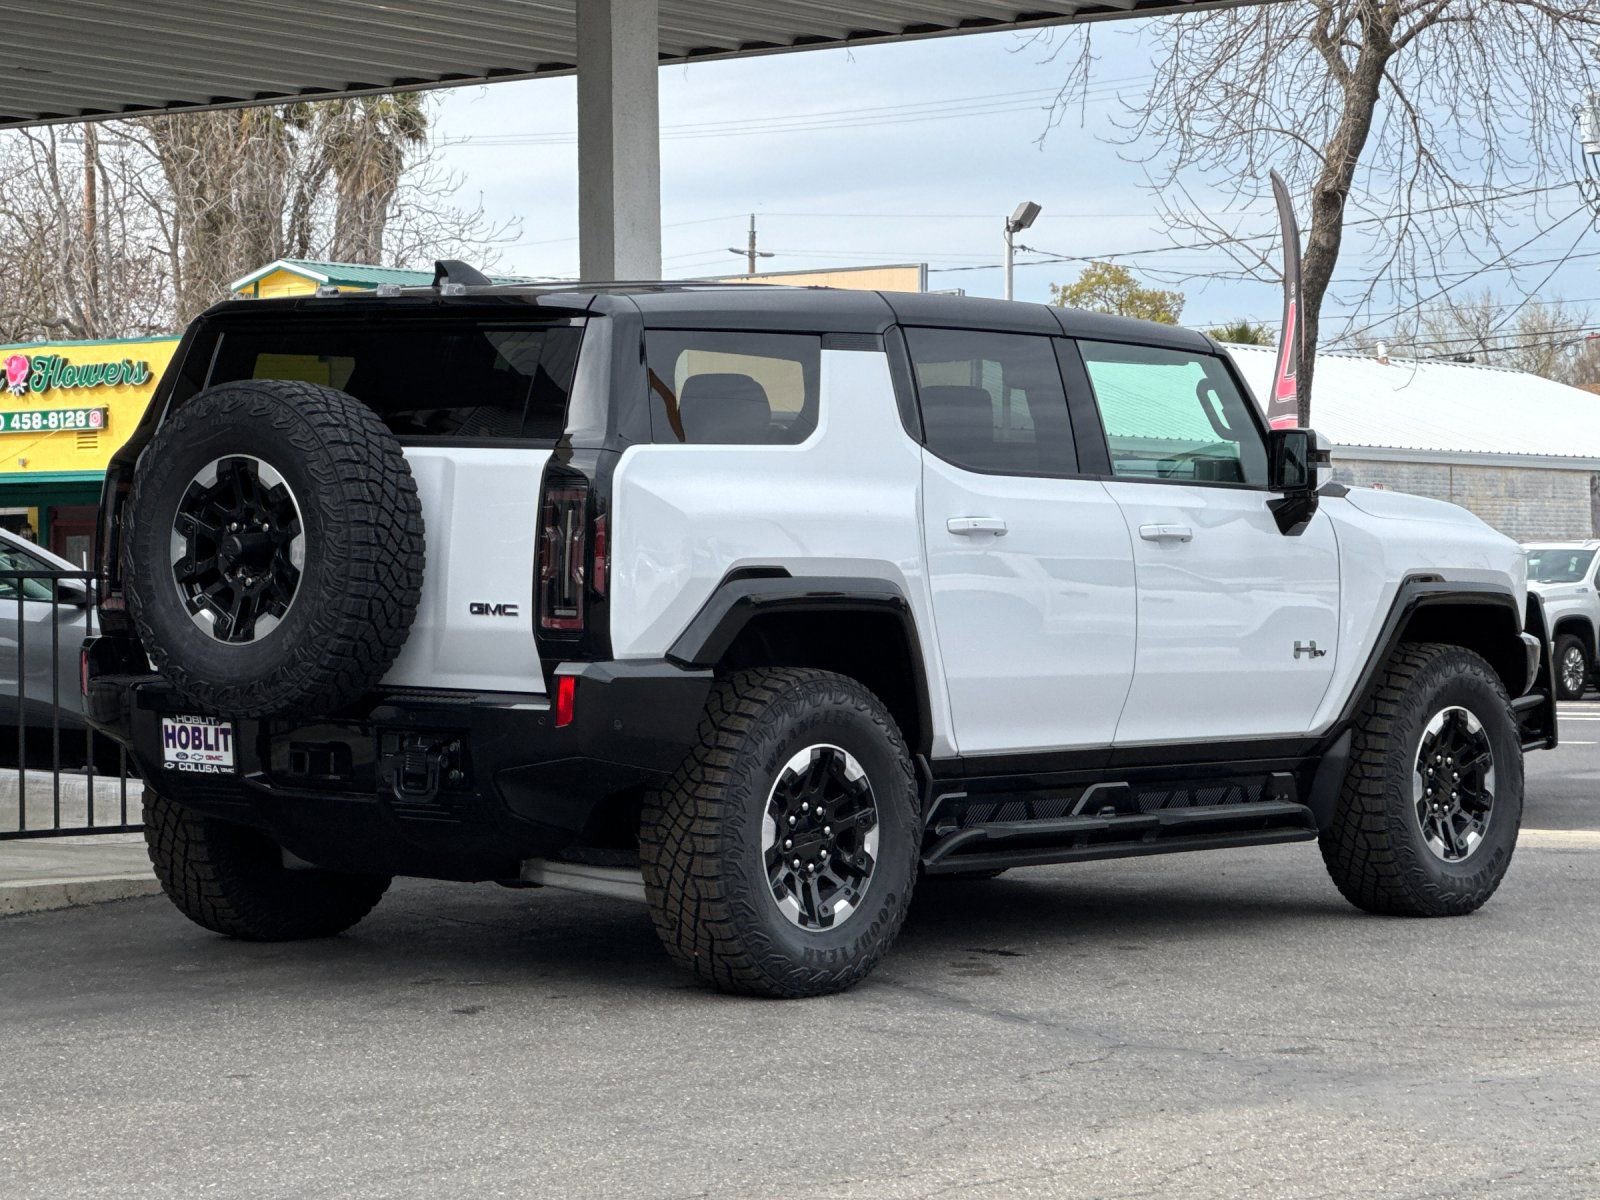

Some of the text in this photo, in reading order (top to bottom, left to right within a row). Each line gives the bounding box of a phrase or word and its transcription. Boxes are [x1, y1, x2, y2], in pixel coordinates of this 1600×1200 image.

[29, 354, 148, 393] Flowers
[10, 411, 86, 430] 458-8128
[469, 602, 519, 617] GMC
[176, 715, 216, 725] HOBLIT
[164, 725, 231, 752] HOBLIT
[179, 763, 219, 773] COLUSA
